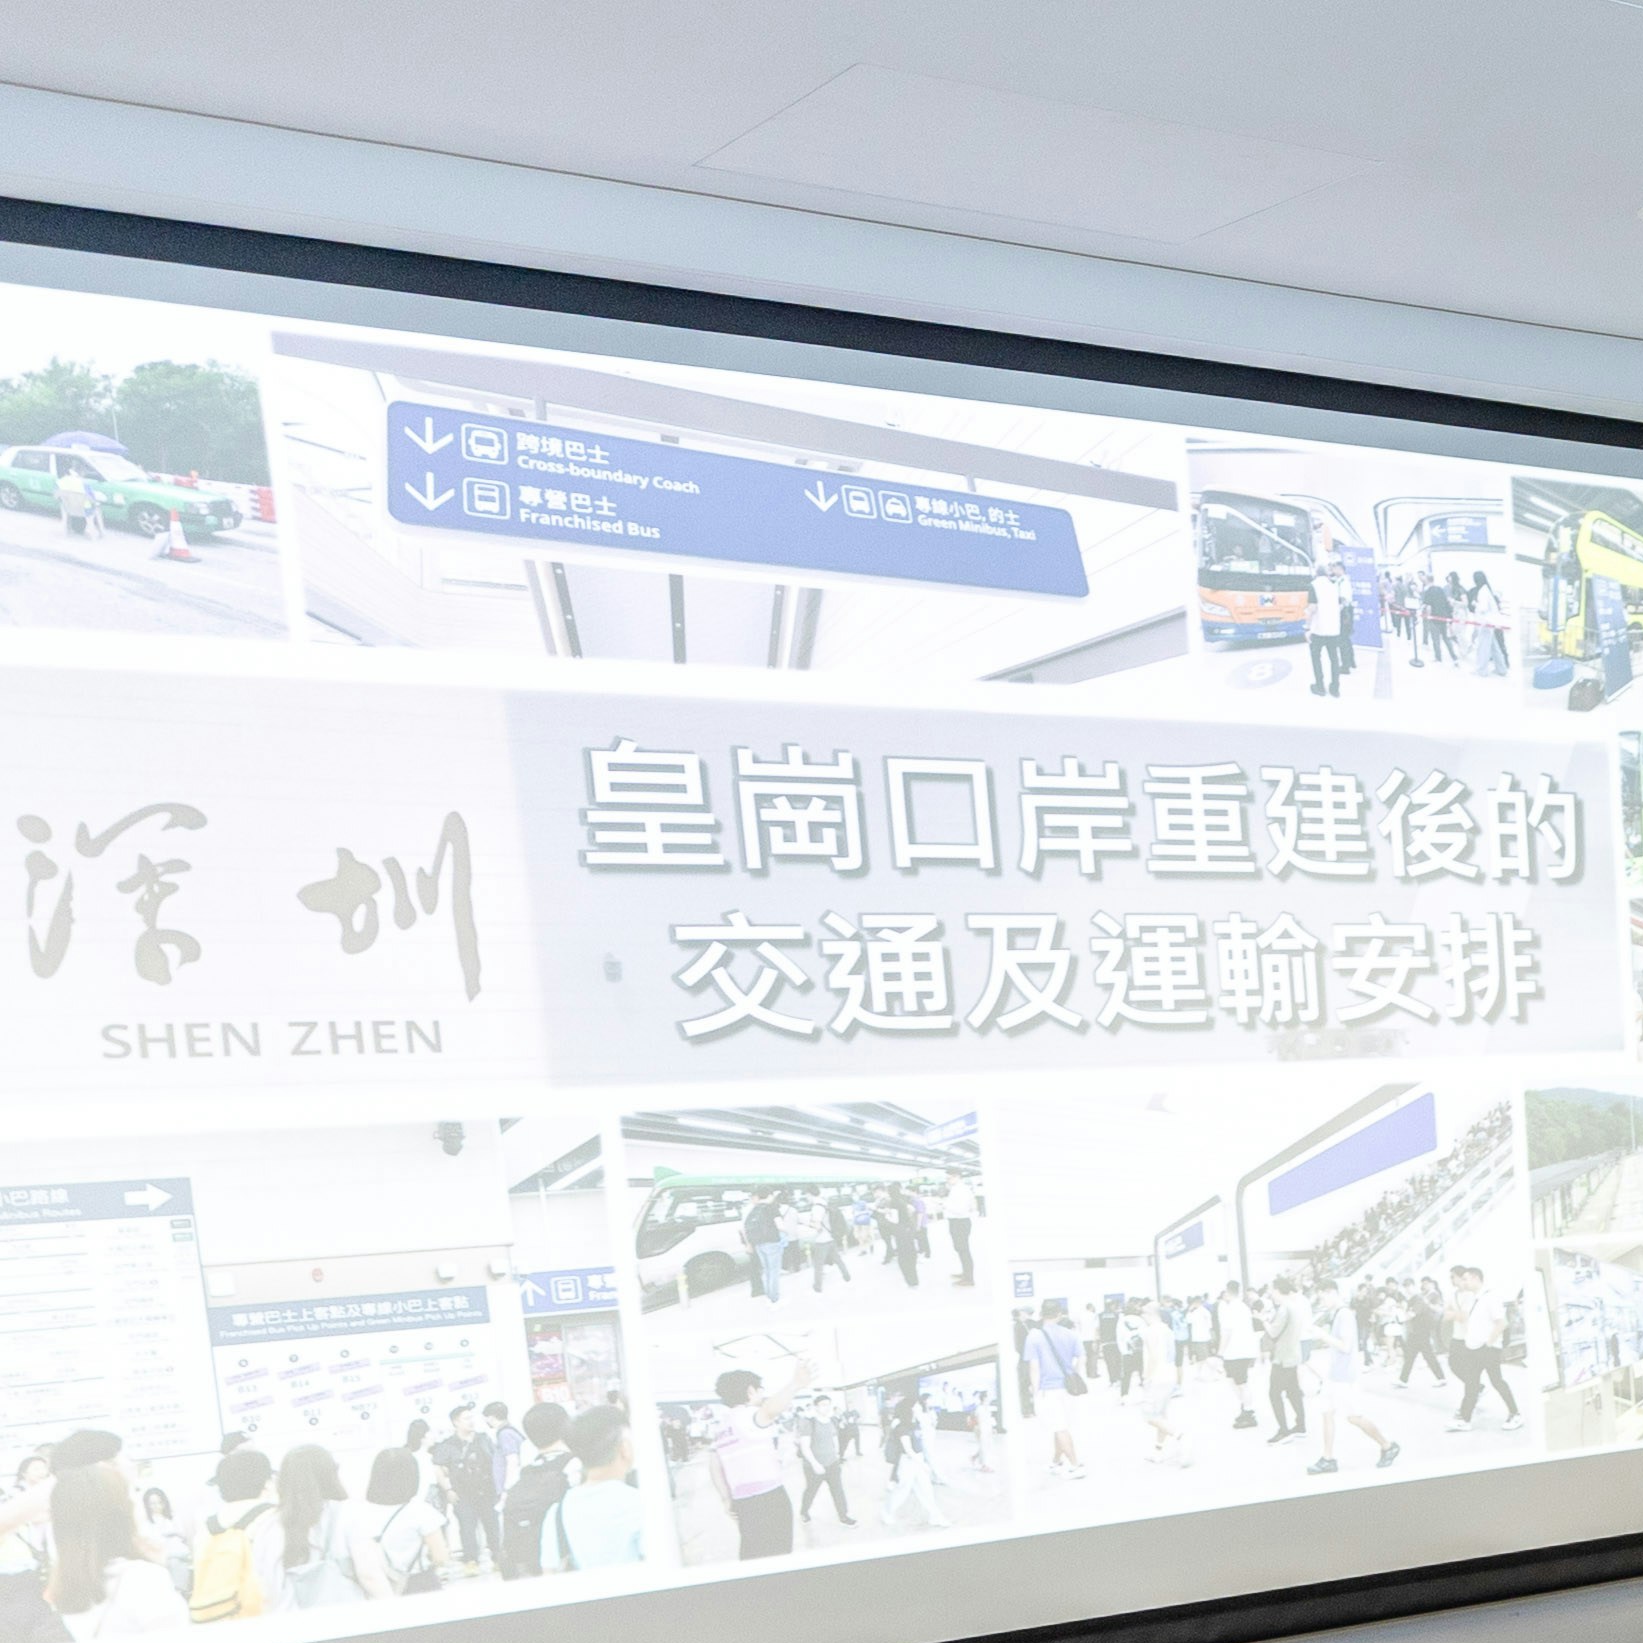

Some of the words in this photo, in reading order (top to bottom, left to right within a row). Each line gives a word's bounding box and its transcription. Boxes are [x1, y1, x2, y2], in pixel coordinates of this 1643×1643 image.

[515, 431, 610, 465] 跨境巴士
[517, 455, 649, 489] Cross-boundary
[652, 476, 700, 494] Coach
[518, 485, 617, 517] 專營巴士
[519, 508, 624, 535] Franchised
[627, 522, 661, 539] Bus
[918, 515, 957, 530] Green
[1013, 527, 1037, 541] Taxi
[583, 737, 1582, 883] 皇崗口岸重建後的
[16, 802, 482, 1002] 深圳
[671, 907, 1546, 1042] 交通及運輸安排
[100, 1021, 262, 1059] SHEN
[287, 1019, 444, 1056] ZHEN
